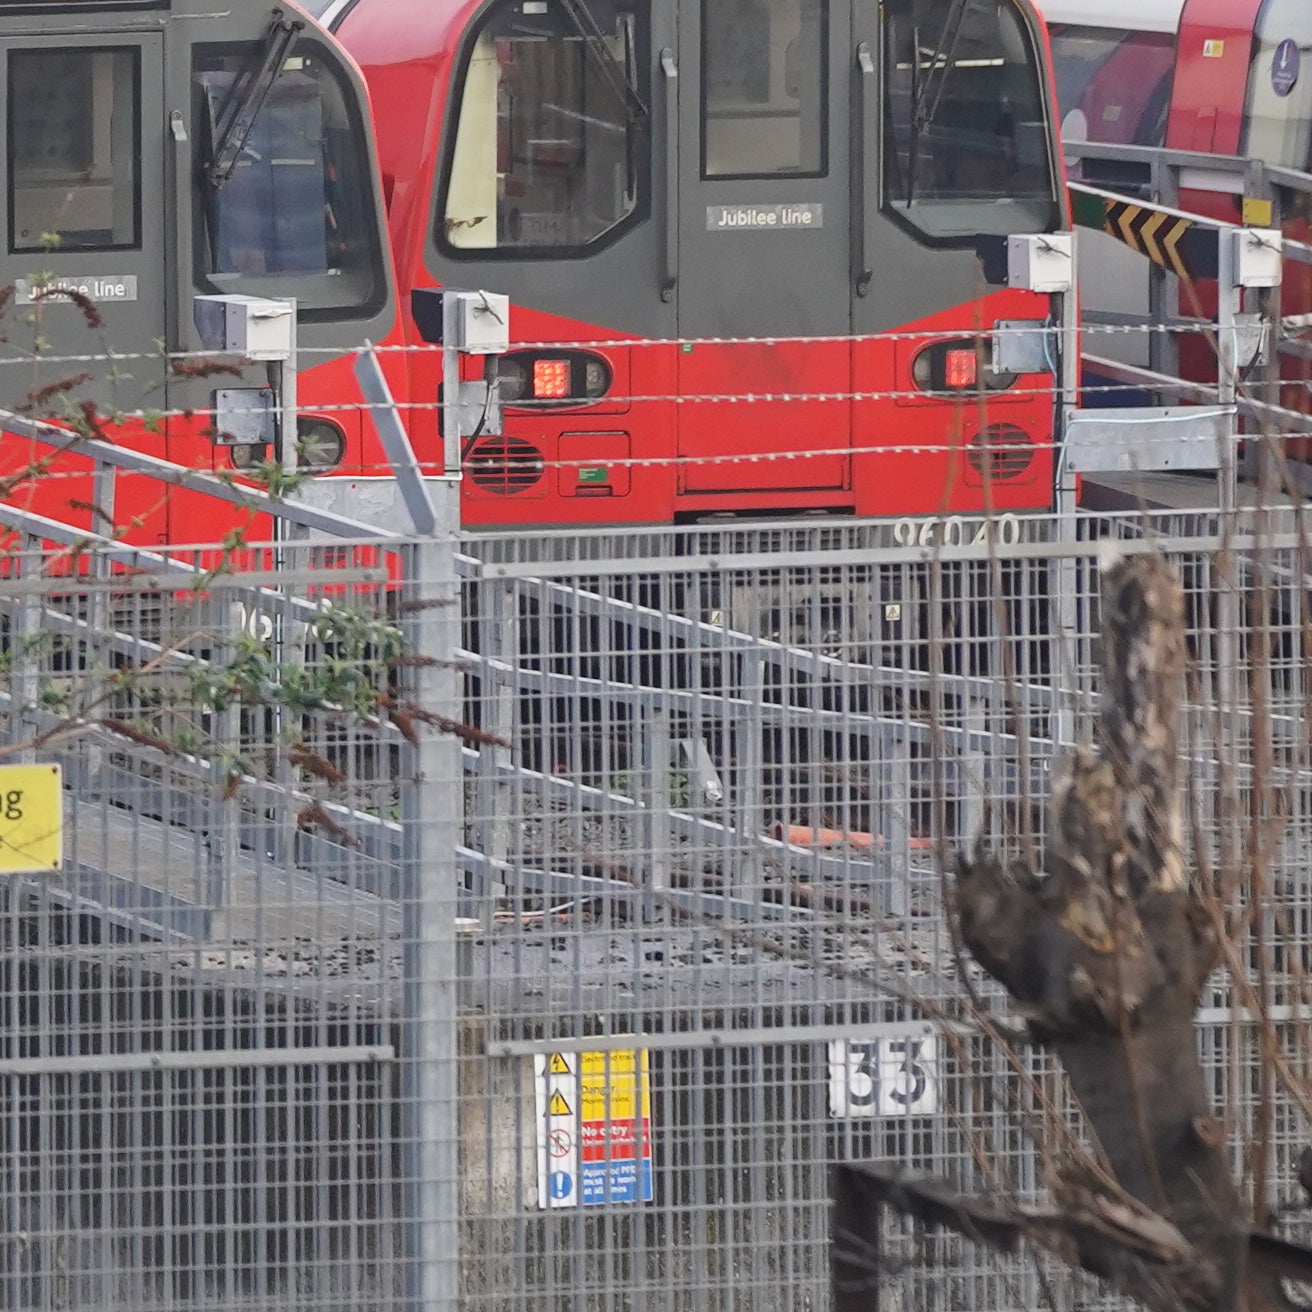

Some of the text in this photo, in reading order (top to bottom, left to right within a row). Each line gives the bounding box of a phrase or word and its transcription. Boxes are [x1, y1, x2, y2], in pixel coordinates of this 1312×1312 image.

[718, 208, 812, 227] Jubilee line
[94, 280, 126, 297] line
[849, 1041, 926, 1106] 33
[582, 1126, 597, 1137] No
